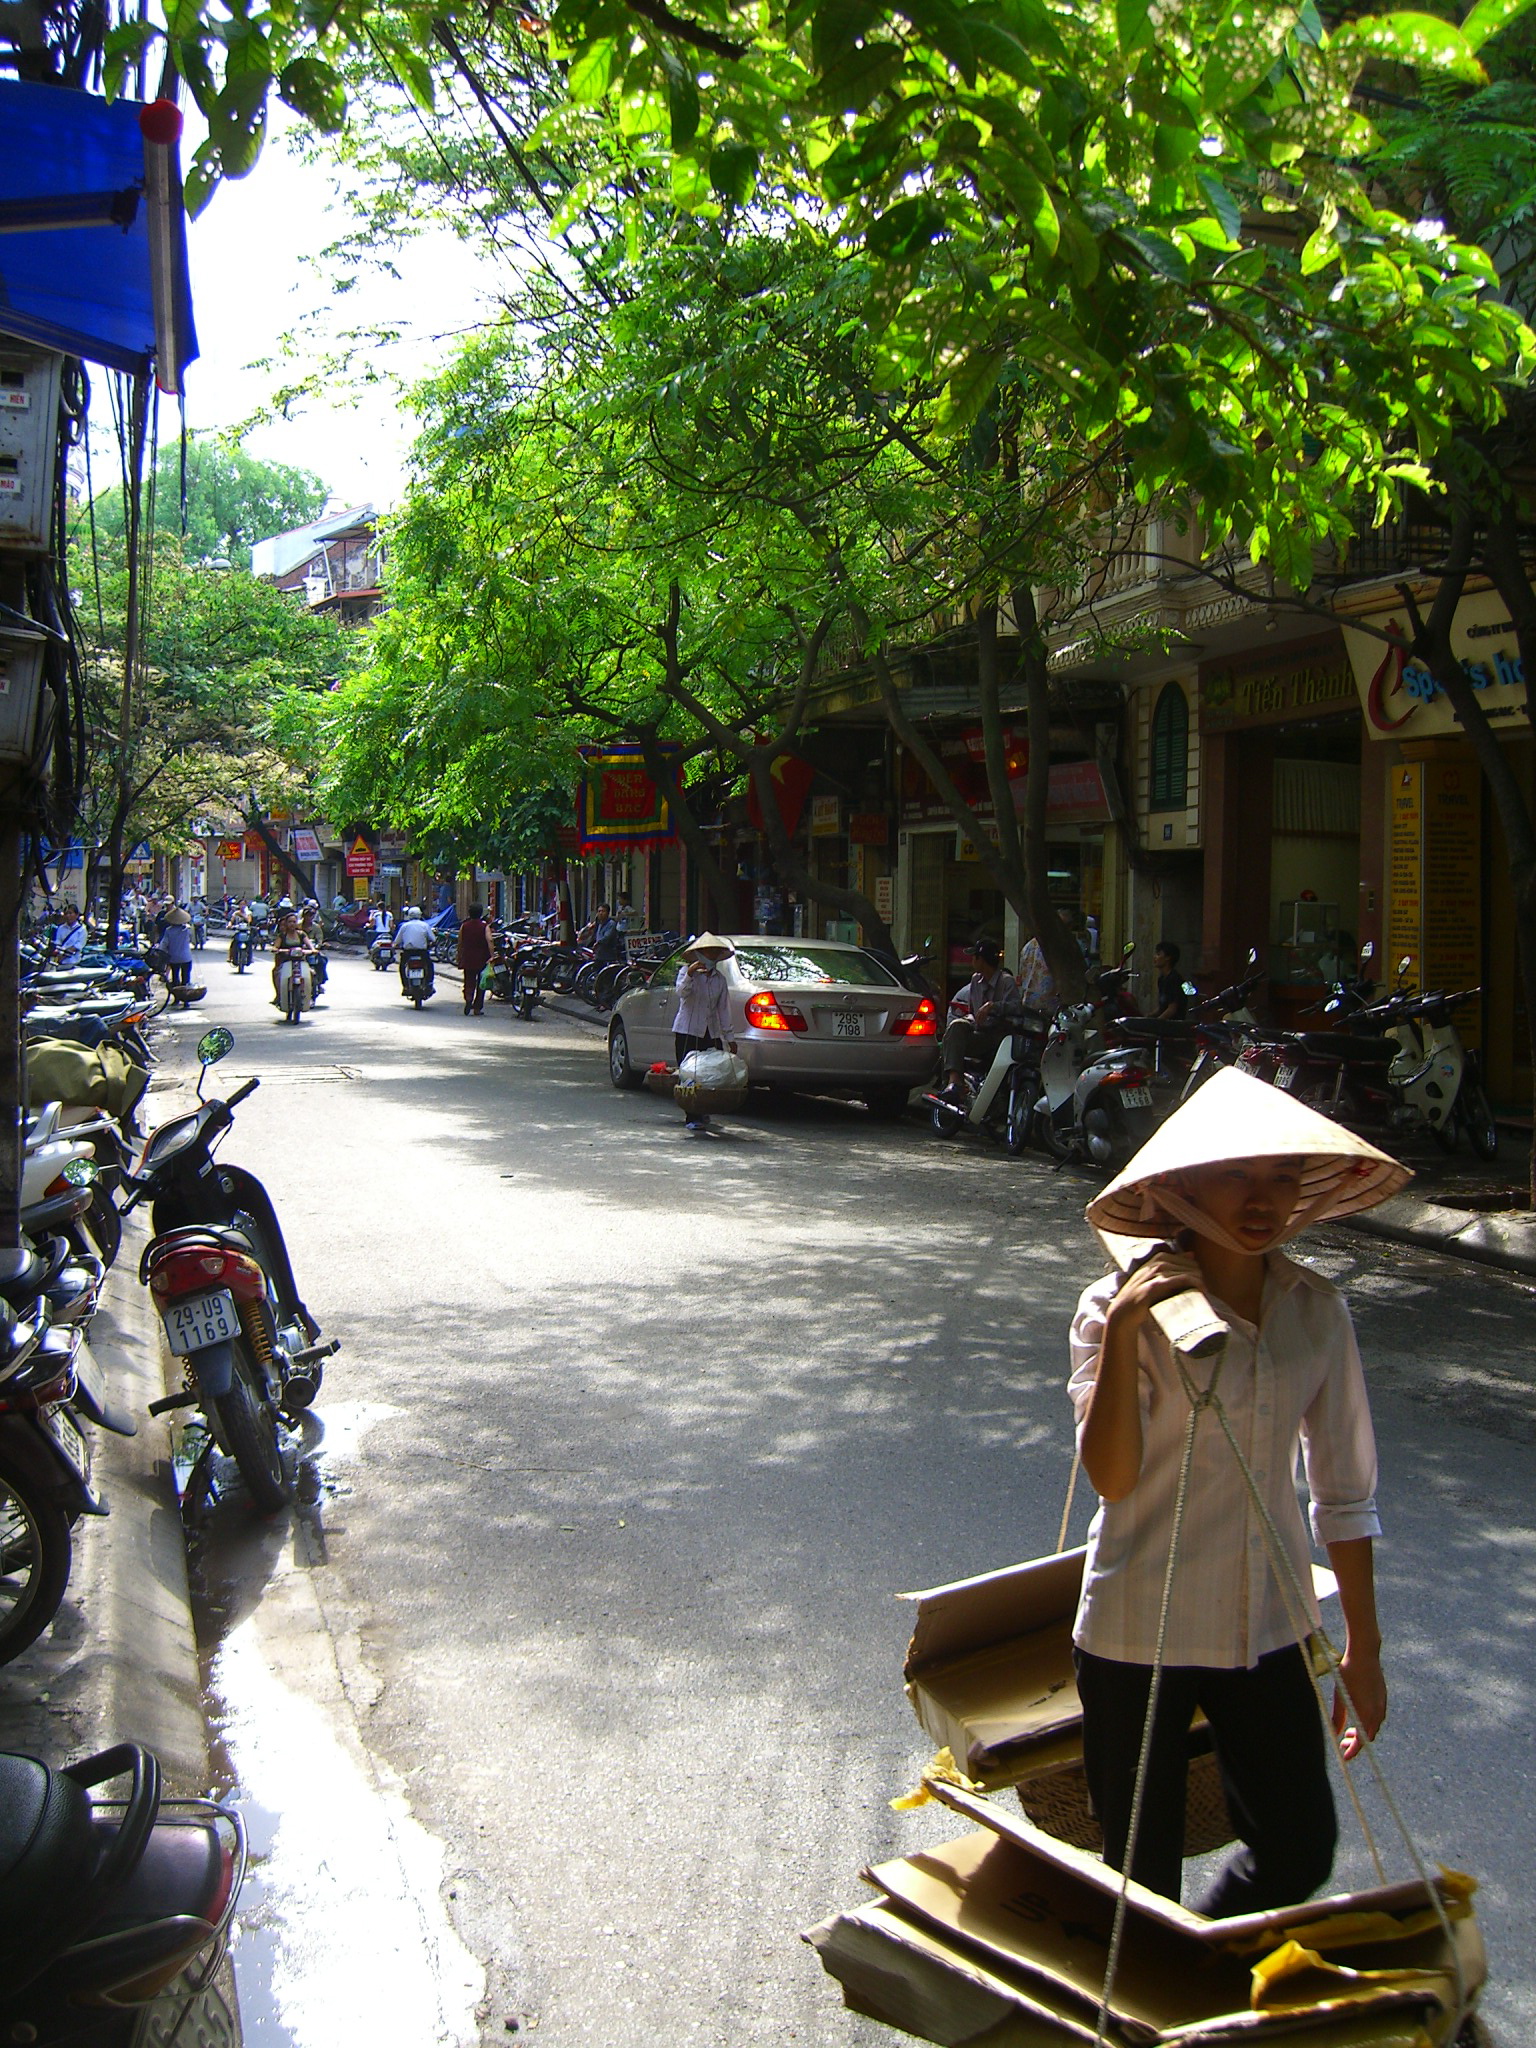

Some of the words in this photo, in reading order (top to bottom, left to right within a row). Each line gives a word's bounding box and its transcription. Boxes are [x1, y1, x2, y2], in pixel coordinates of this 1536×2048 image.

[628, 938, 642, 949] FOR
[839, 1013, 859, 1024] 29S
[837, 1024, 860, 1036] 7198
[173, 1297, 224, 1329] 29-U9
[179, 1317, 229, 1348] 1169
